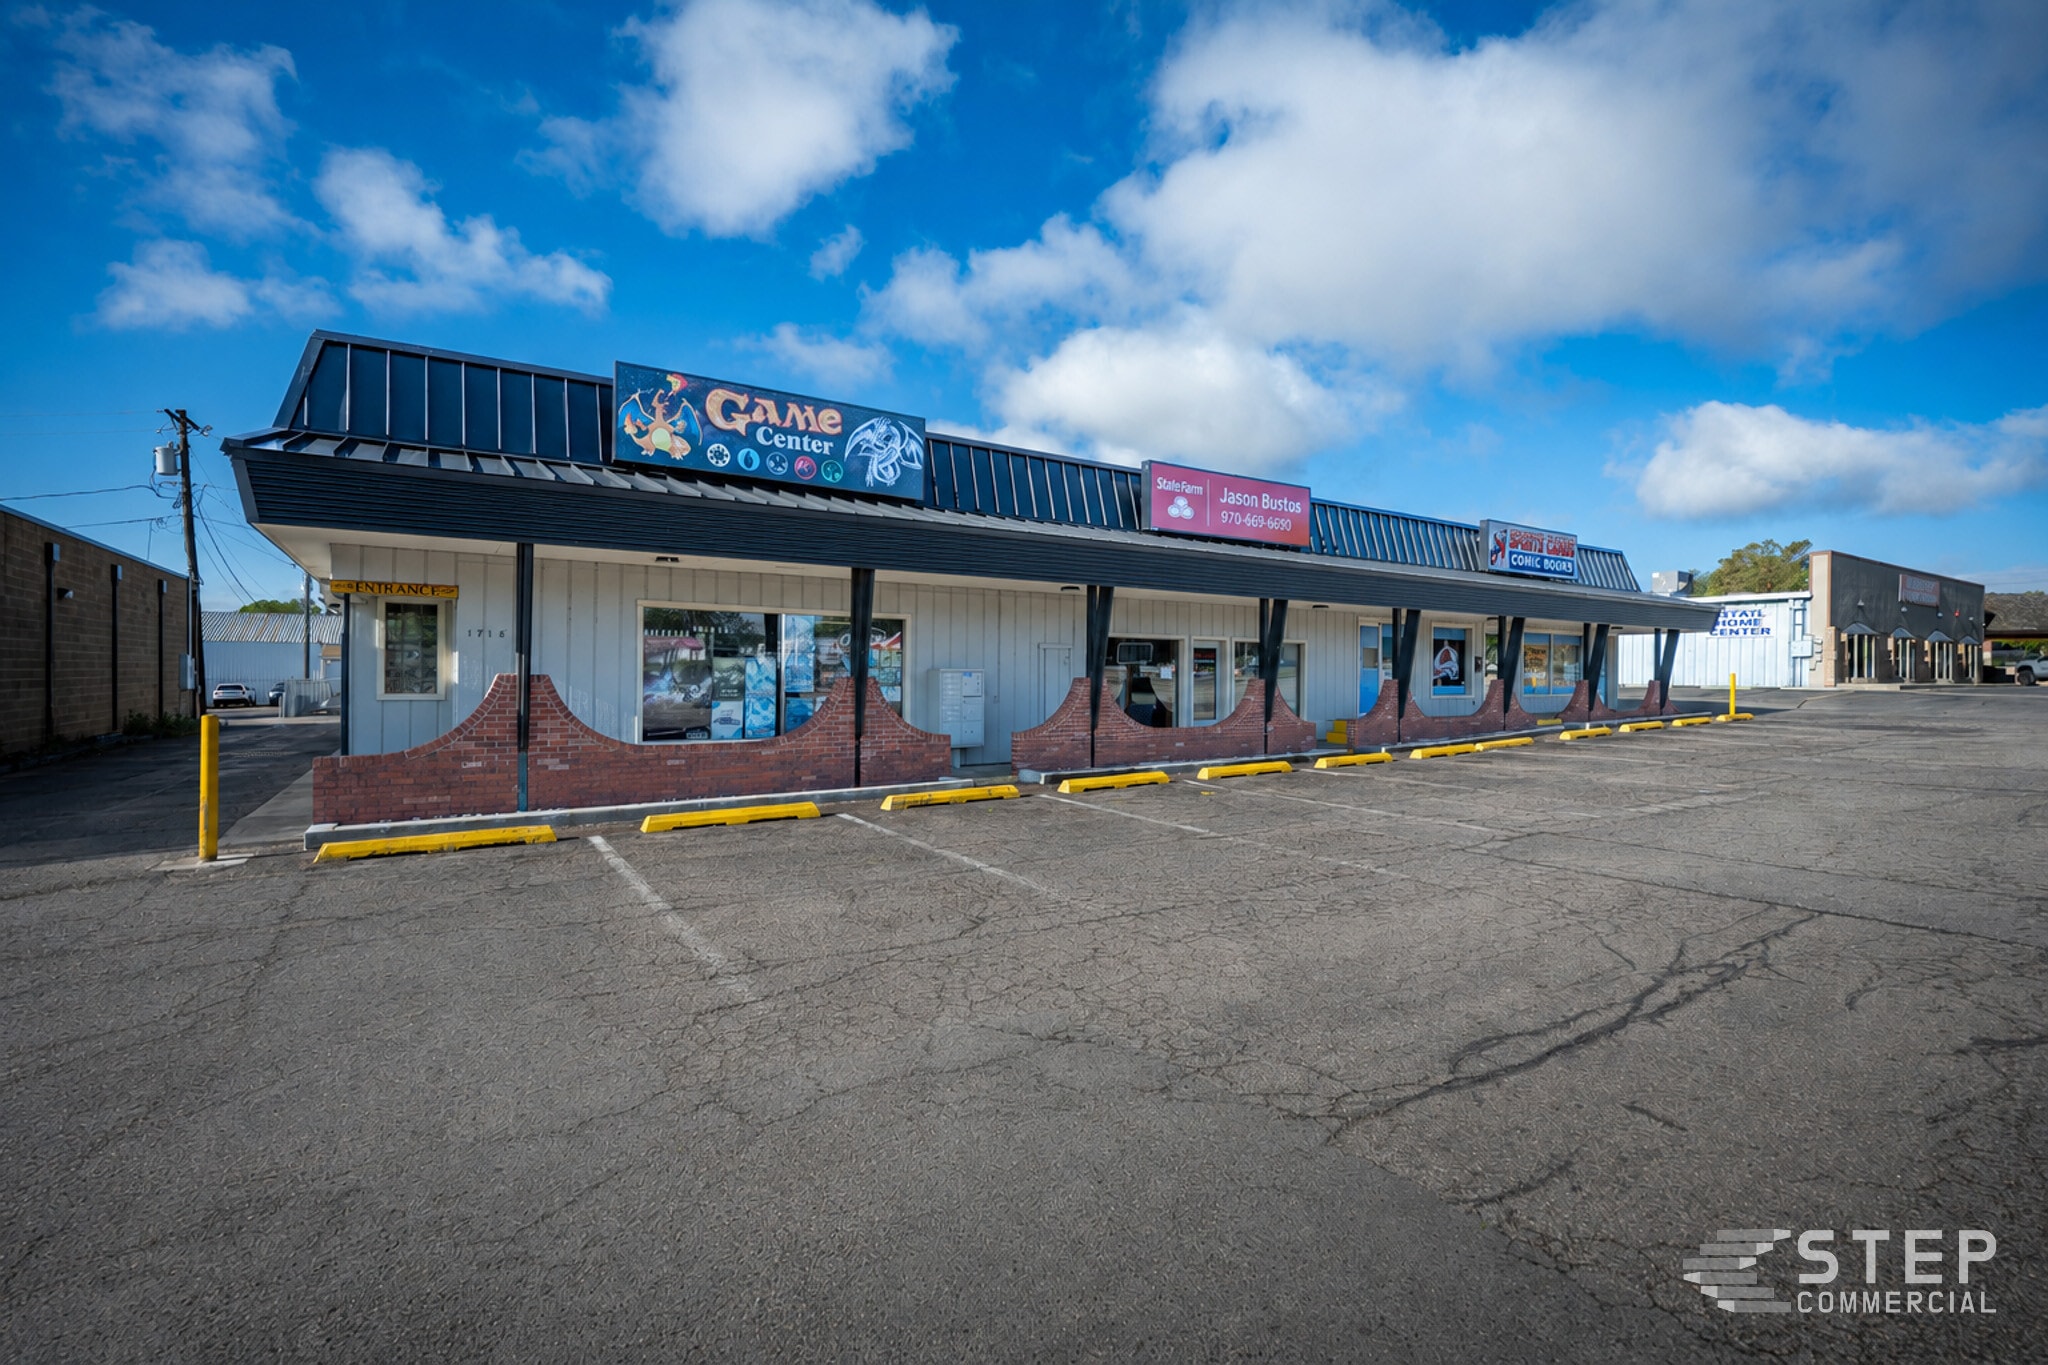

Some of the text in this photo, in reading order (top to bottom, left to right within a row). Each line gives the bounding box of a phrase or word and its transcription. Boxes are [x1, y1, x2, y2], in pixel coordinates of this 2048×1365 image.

[756, 426, 834, 455] Center
[1219, 488, 1302, 514] Jason Bustos
[1511, 554, 1541, 568] COMIC
[356, 581, 439, 597] ENTRANCE
